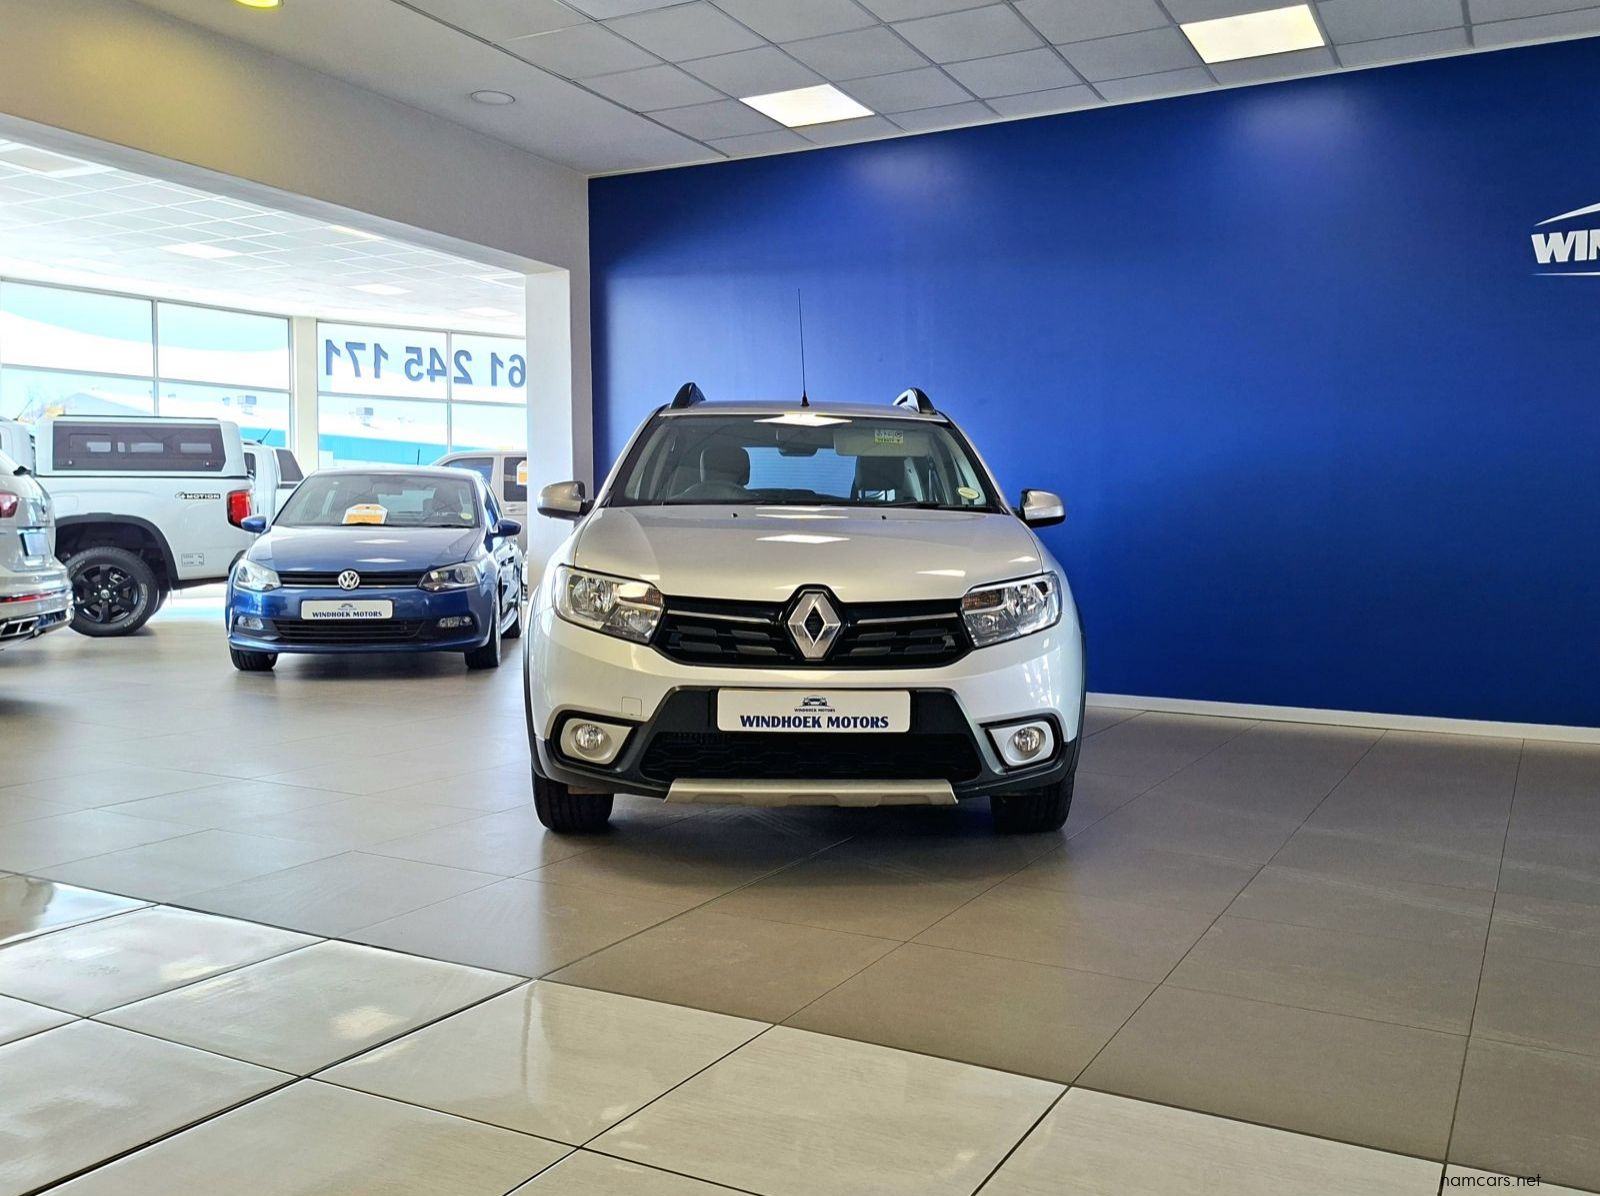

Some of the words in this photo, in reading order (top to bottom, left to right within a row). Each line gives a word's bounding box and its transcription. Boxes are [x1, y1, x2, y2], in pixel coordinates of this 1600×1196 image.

[353, 610, 382, 618] MOTORS
[740, 715, 823, 728] WINDHOEK
[827, 715, 889, 728] MOTORS
